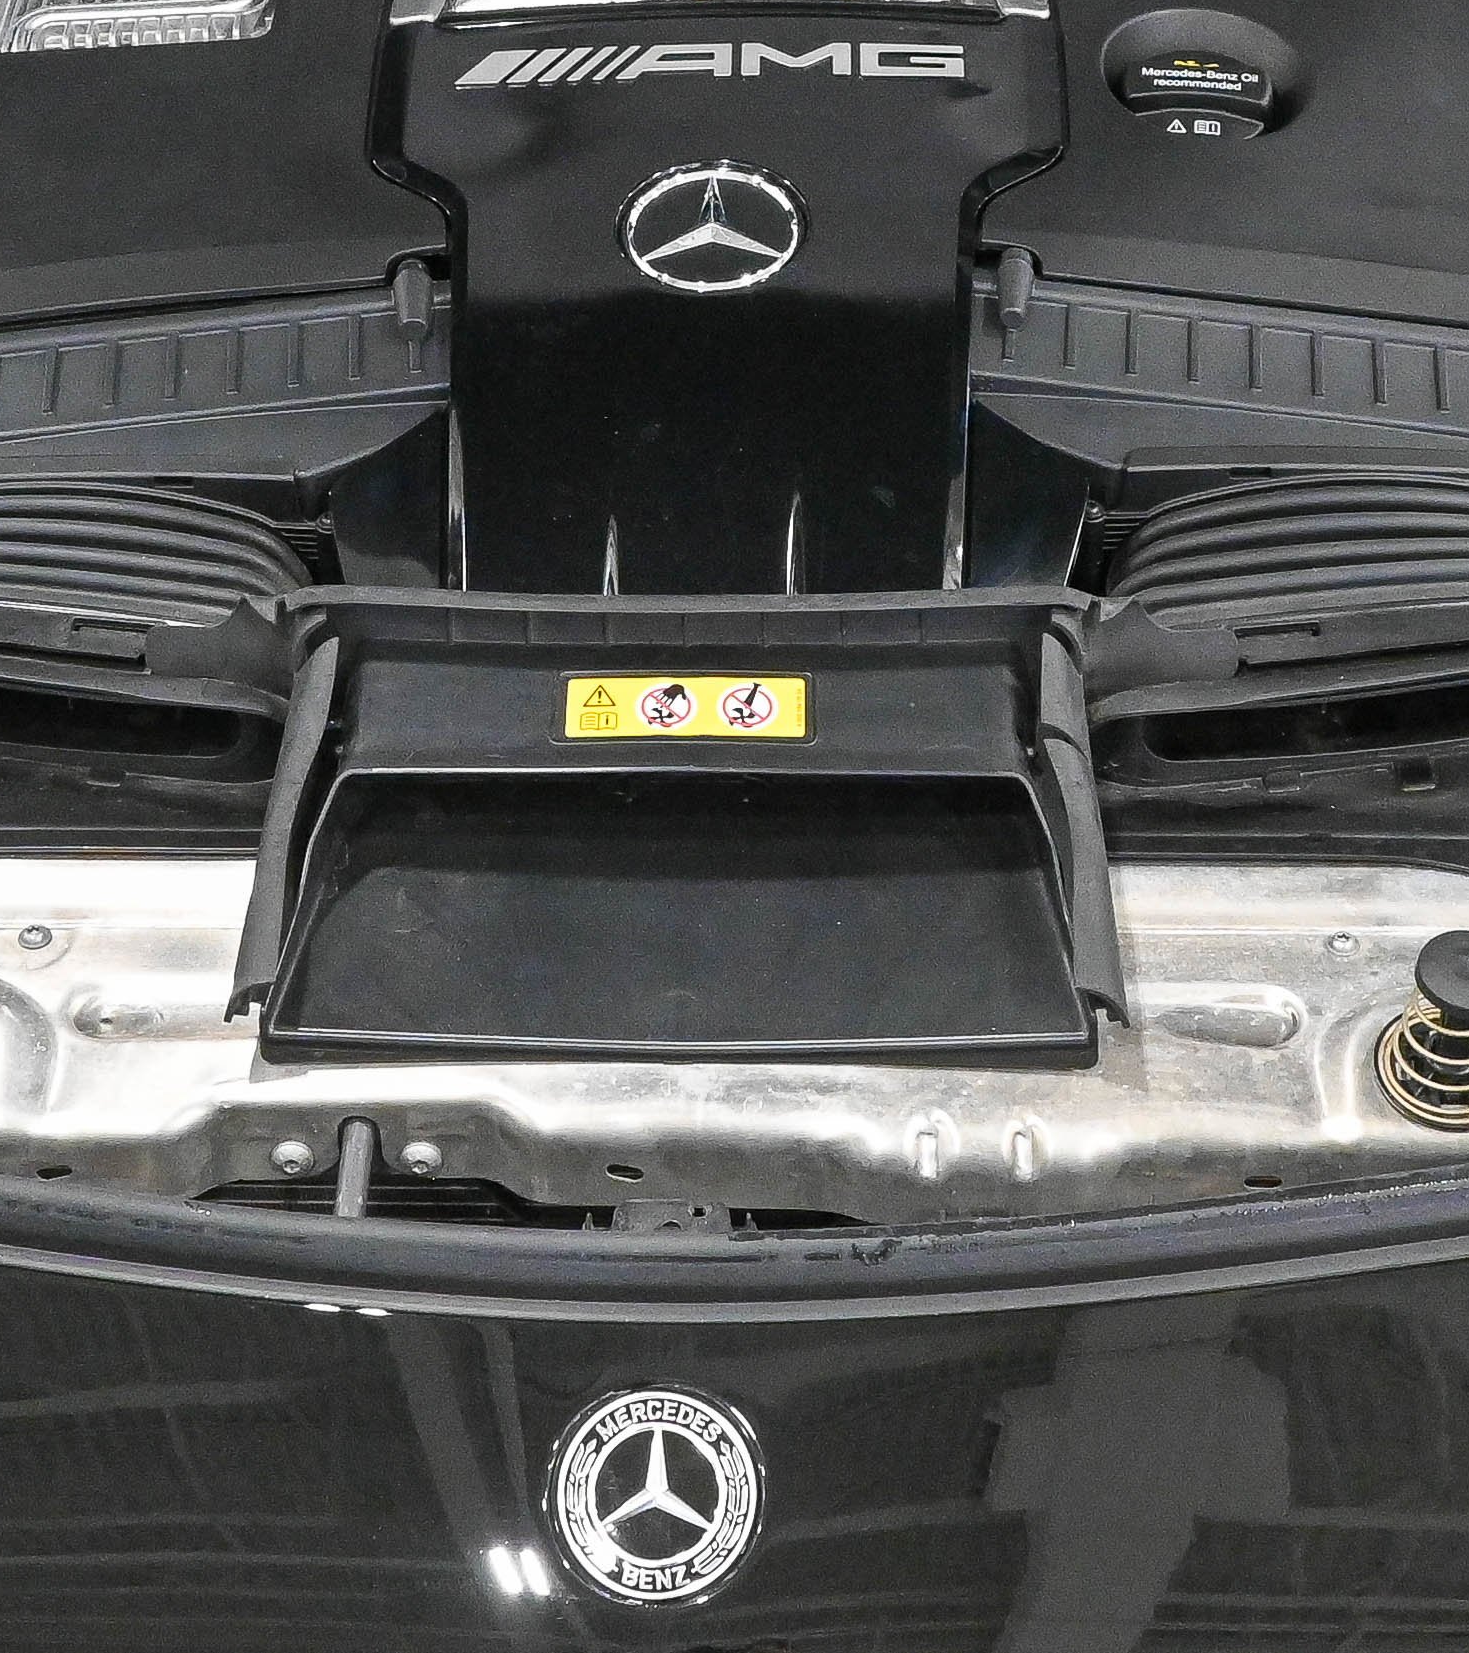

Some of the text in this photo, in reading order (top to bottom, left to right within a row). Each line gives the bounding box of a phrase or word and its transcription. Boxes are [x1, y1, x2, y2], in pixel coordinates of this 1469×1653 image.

[617, 42, 965, 79] AMG
[1141, 67, 1259, 83] Mercedes-Benz Oil
[1153, 78, 1242, 91] recommended
[594, 1399, 724, 1443] MERCEDES
[620, 1563, 692, 1592] BENZ
